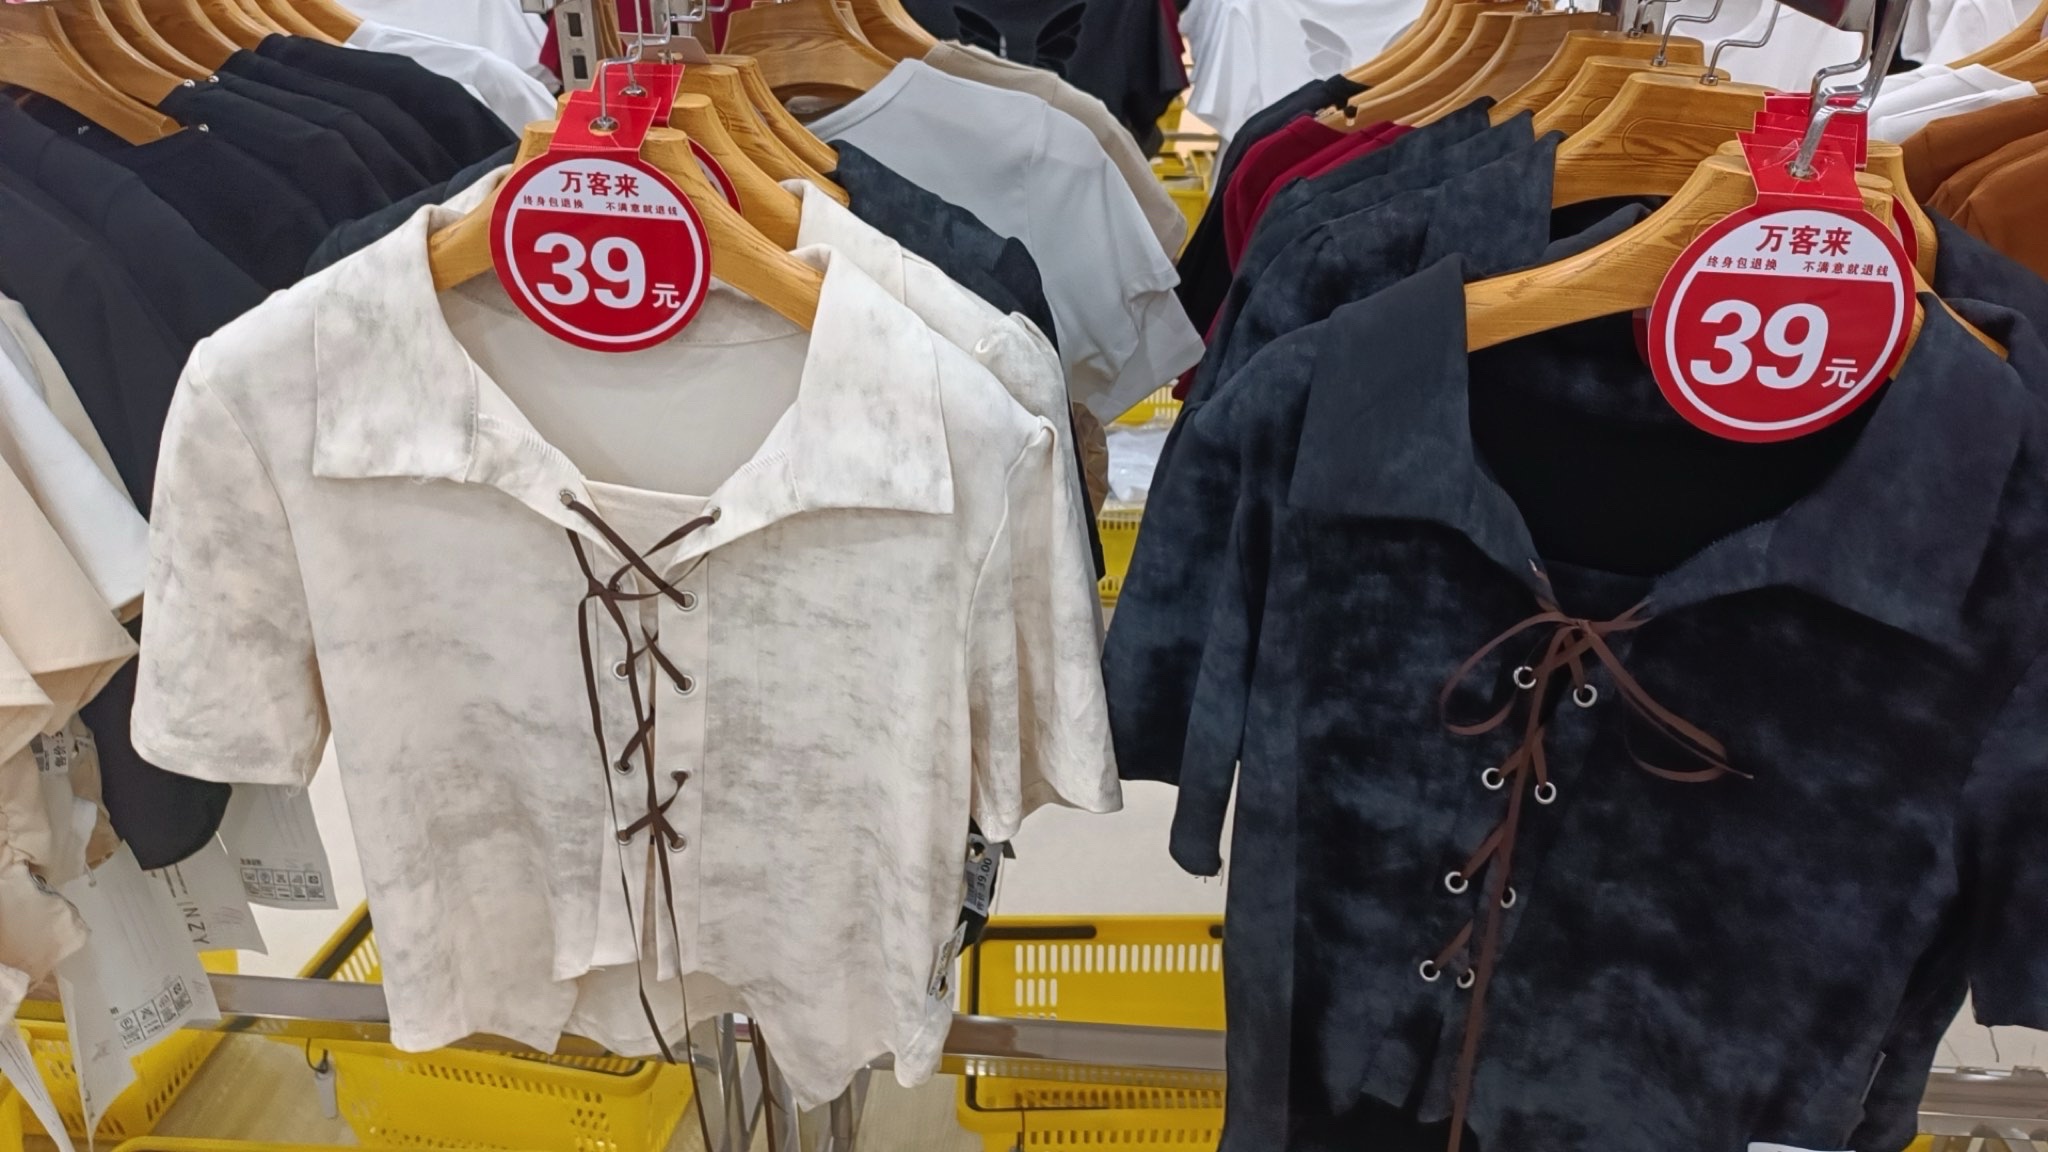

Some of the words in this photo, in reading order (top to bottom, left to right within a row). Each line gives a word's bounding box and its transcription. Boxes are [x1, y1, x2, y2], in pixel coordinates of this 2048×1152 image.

[559, 170, 640, 198] 万客来
[523, 194, 584, 209] 终身包退换
[1755, 225, 1853, 257] 万客来
[1706, 255, 1778, 271] 终身包退换
[1802, 260, 1889, 277] 不满意就退钱
